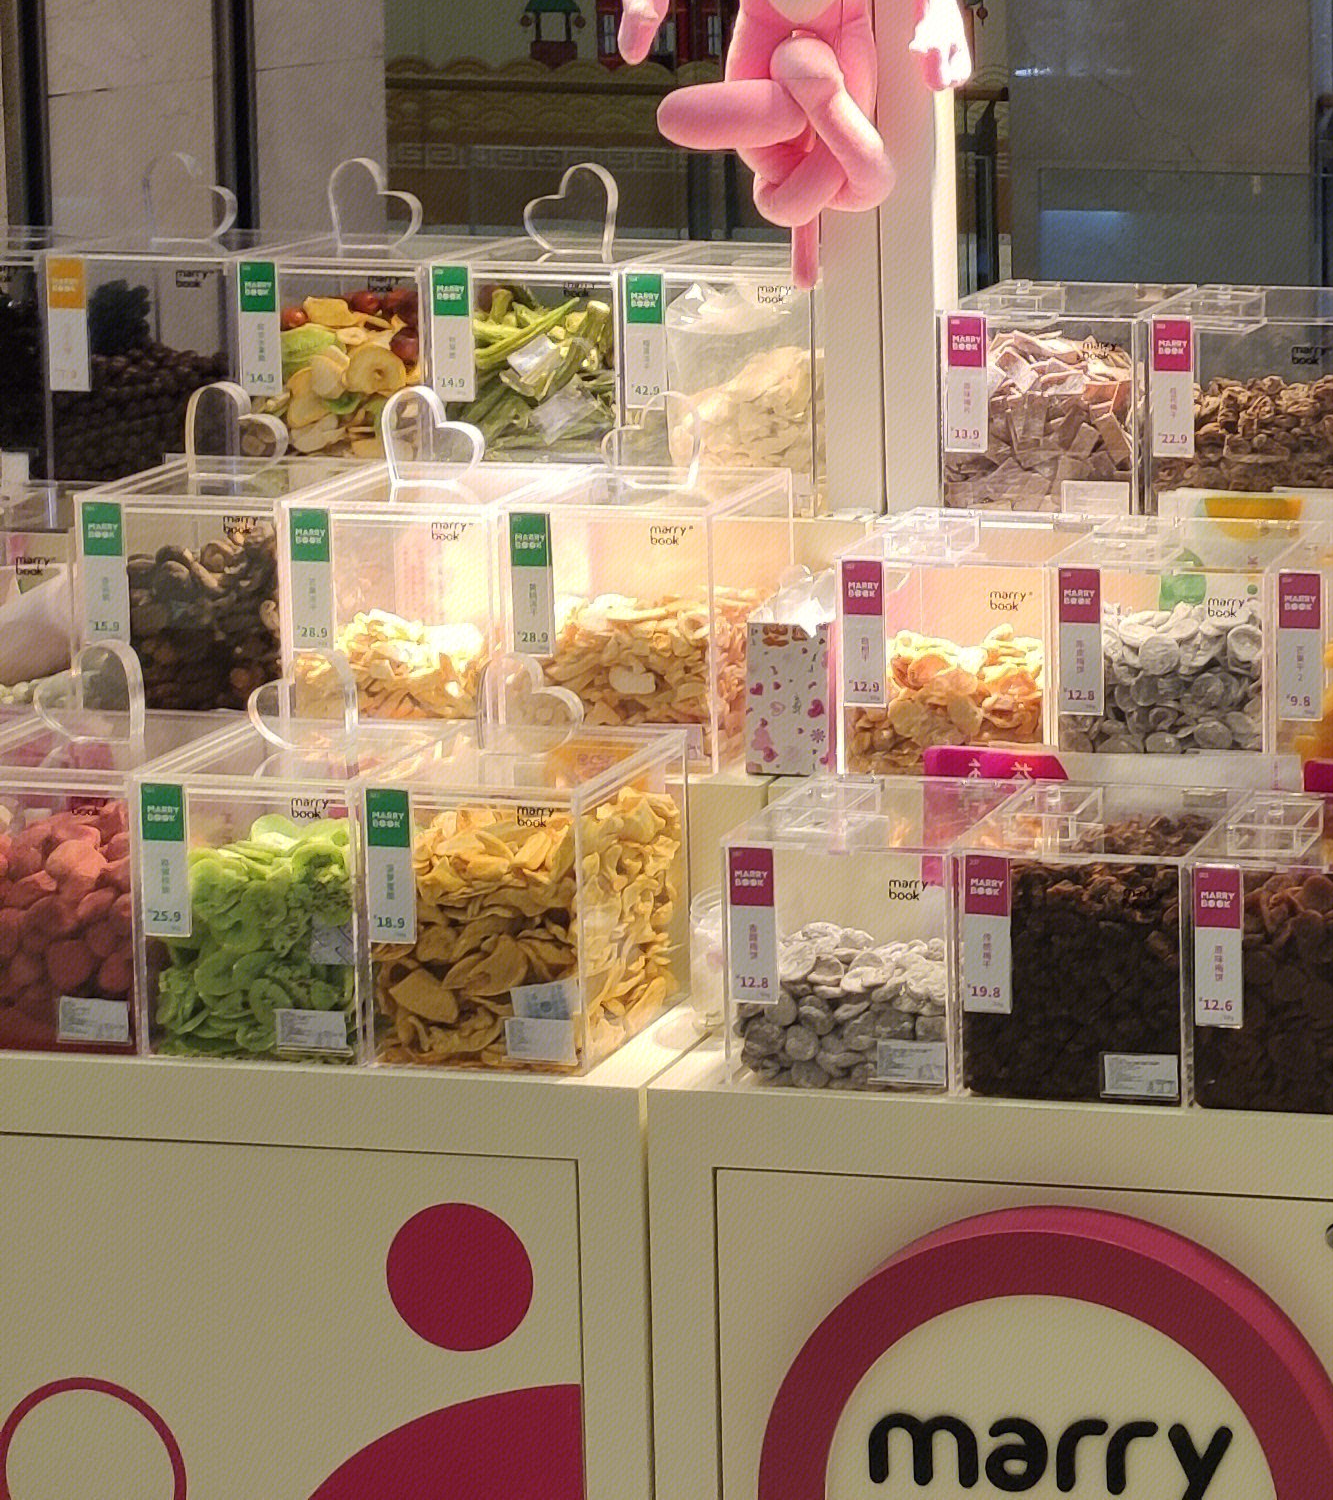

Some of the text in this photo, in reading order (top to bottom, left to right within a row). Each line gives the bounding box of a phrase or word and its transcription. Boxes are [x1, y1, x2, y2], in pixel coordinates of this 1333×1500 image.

[734, 870, 768, 879] MARRY
[734, 878, 764, 887] BOOK
[970, 878, 1004, 888] MARRY
[970, 886, 999, 896] BOOK
[1200, 891, 1235, 901] MARRY
[1200, 899, 1230, 909] BOOK
[868, 1412, 1233, 1500] marry
